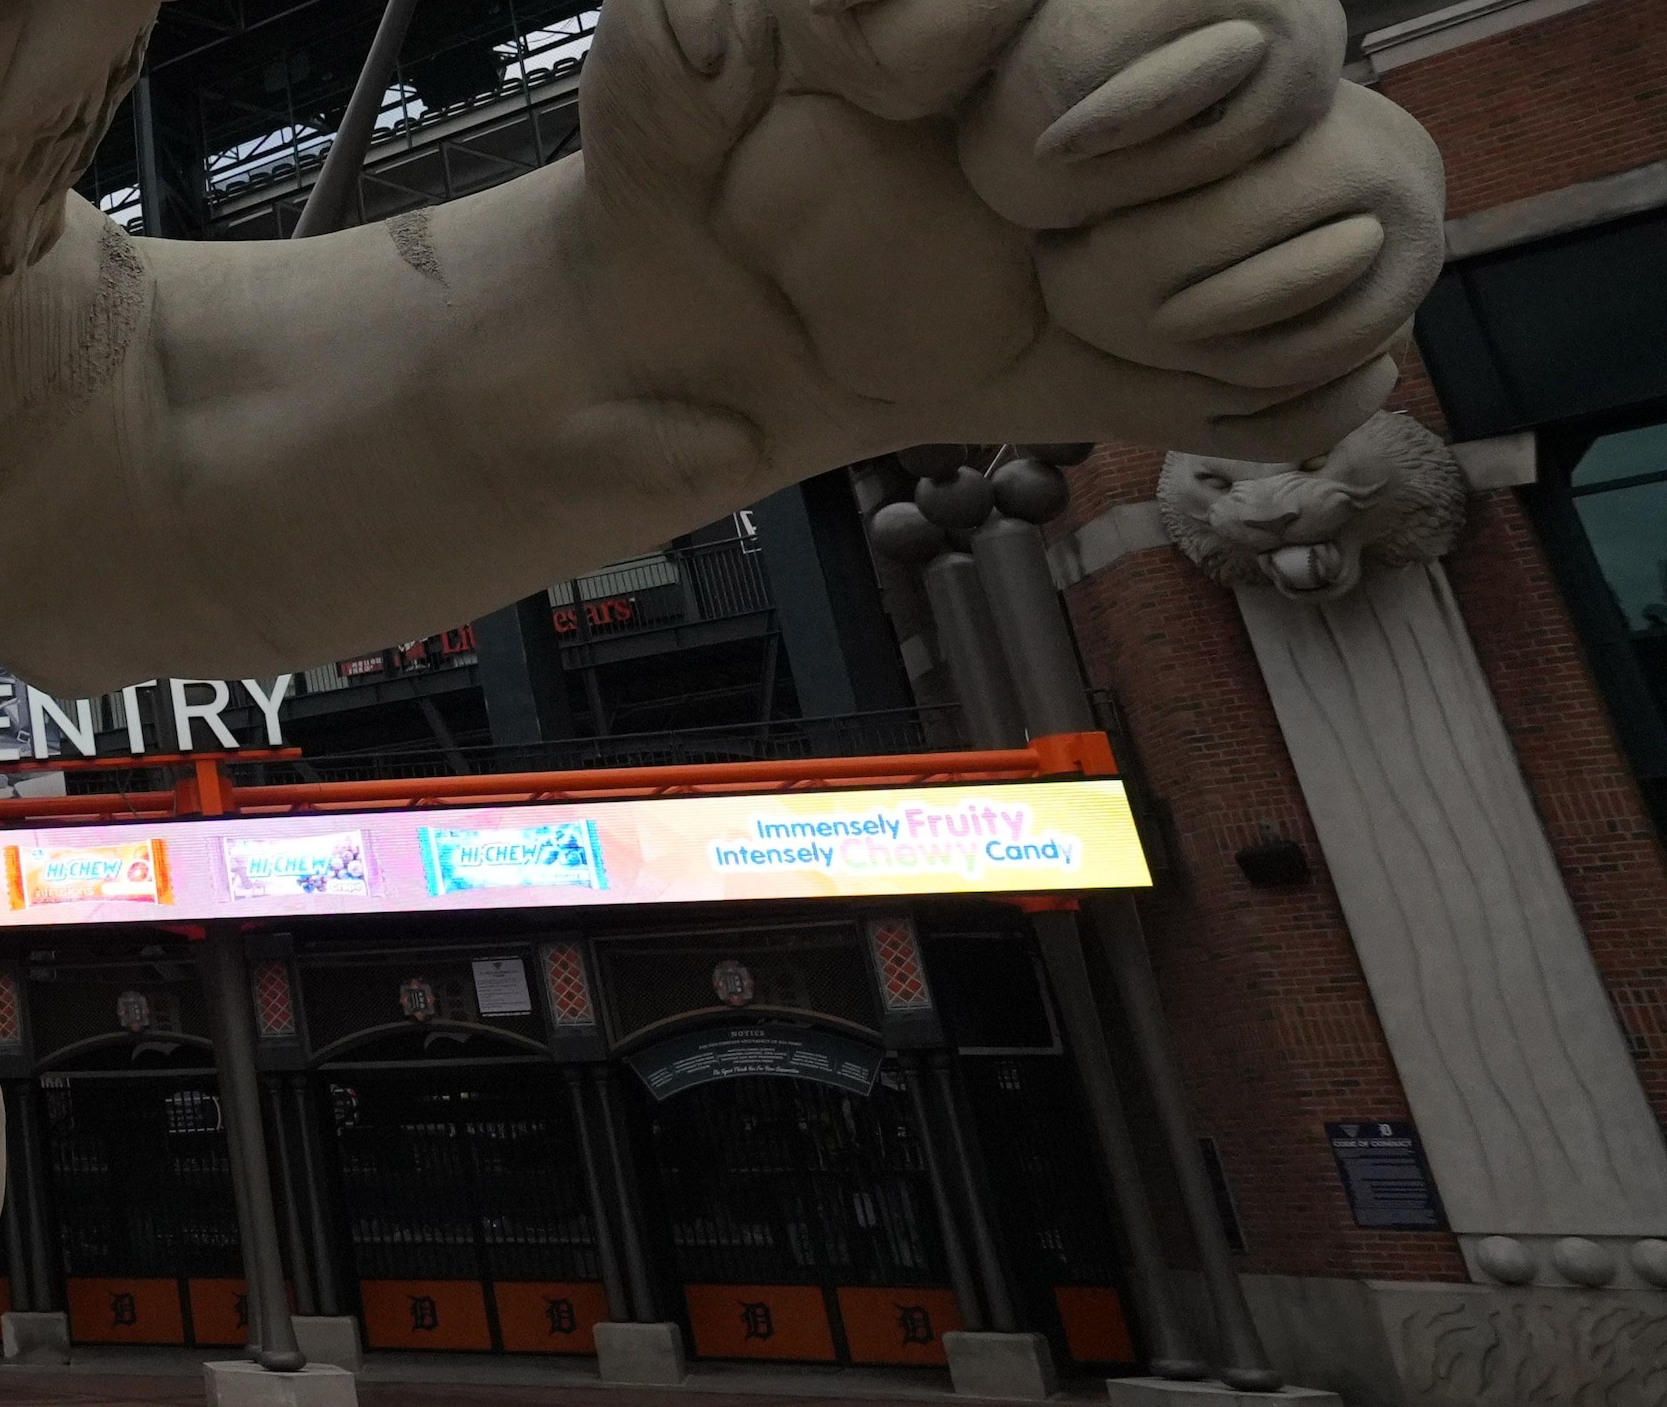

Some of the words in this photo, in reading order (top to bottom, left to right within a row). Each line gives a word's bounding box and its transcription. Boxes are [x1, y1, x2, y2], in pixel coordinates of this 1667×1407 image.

[757, 814, 899, 839] Immensely
[905, 805, 1024, 840] Fruity
[716, 842, 833, 866] Intensely
[840, 837, 977, 871] Chewy
[986, 839, 1073, 864] Candy
[731, 1030, 764, 1038] NOTICE
